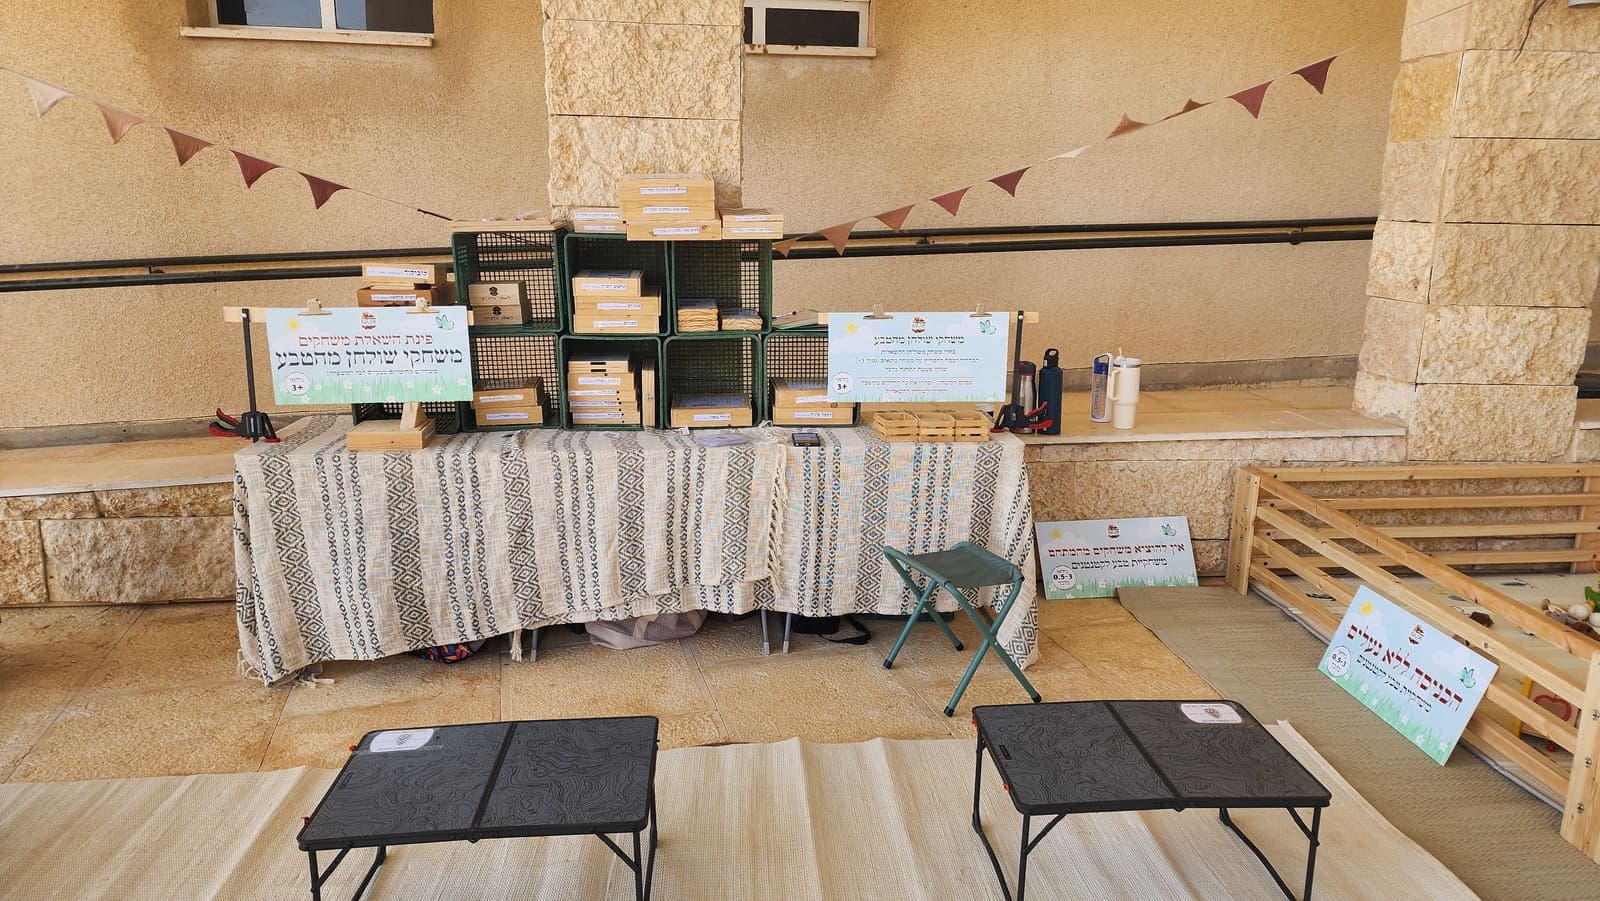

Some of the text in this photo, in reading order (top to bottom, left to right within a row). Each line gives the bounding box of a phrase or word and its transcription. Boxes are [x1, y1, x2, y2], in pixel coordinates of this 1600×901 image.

[299, 334, 433, 349] פינת השאלת משחקים
[874, 335, 965, 346] משחקי שולחן מהטבע
[275, 349, 463, 370] משחקי שולחן מהטבע
[292, 384, 304, 392] 3+
[837, 383, 848, 391] 3+
[1048, 540, 1185, 559] אין להוציא משחקים מהמתחם
[1071, 560, 1112, 571] לקטנטנים
[1112, 560, 1130, 570] טבע
[1332, 653, 1348, 668] 0.5-3
[1346, 624, 1463, 712] הכניסה ללא נעלים
[1356, 654, 1387, 681] לקטנטנים
[1384, 673, 1401, 691] טבע
